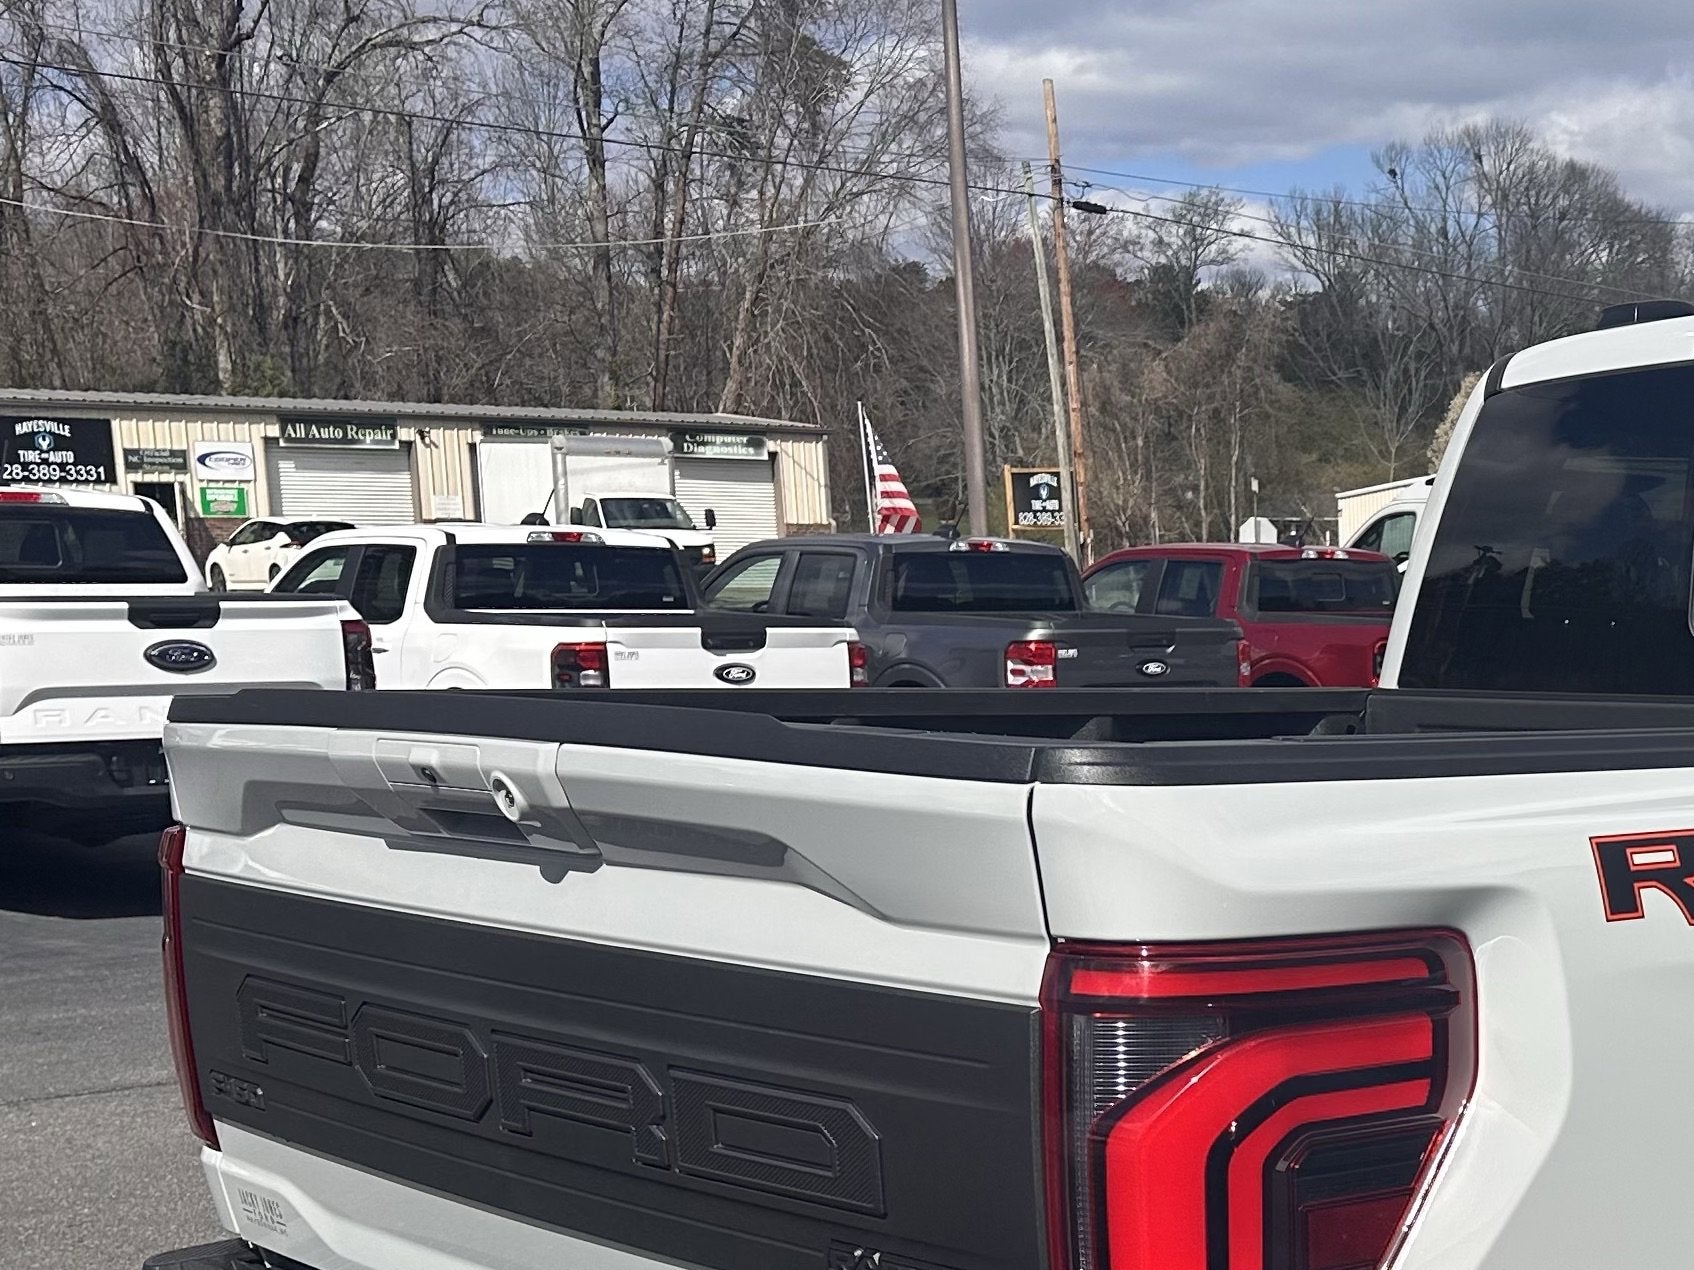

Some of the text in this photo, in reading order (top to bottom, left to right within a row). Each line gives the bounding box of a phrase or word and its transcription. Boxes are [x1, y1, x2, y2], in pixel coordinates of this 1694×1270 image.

[15, 420, 71, 437] HAYESVILLE
[284, 423, 393, 443] All Auto Repair
[685, 434, 749, 444] Computer
[683, 443, 754, 455] Diagnostics
[2, 464, 105, 480] 28-389-3331
[236, 973, 887, 1219] FORD
